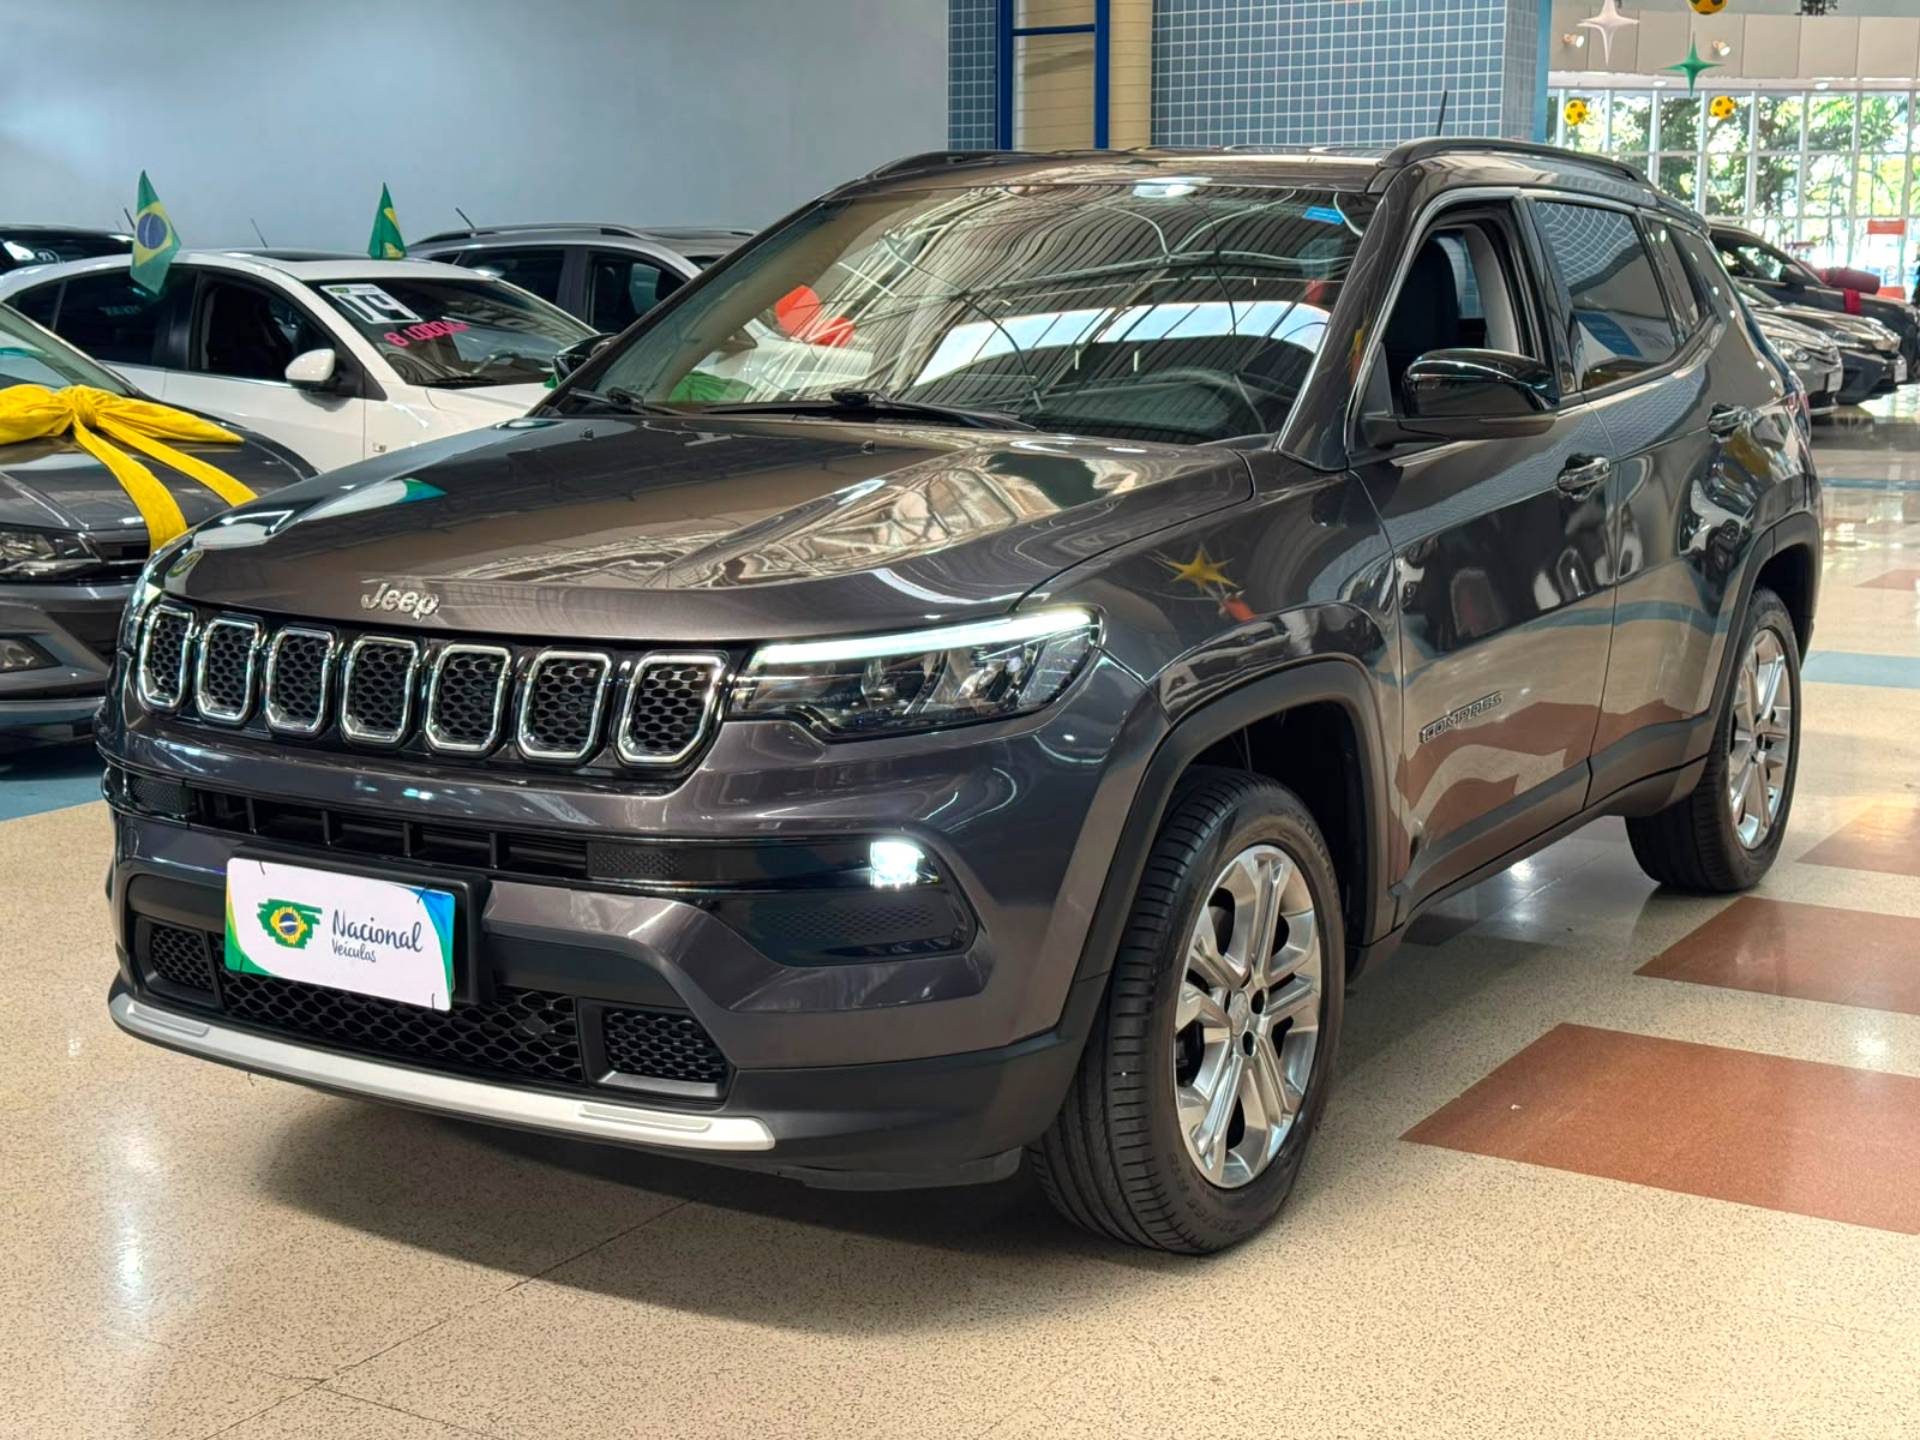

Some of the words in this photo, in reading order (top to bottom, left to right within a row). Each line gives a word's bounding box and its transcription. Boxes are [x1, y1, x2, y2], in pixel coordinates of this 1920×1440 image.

[361, 582, 440, 621] Jeep
[332, 908, 424, 953] Nacional
[331, 938, 377, 963] Veículos
